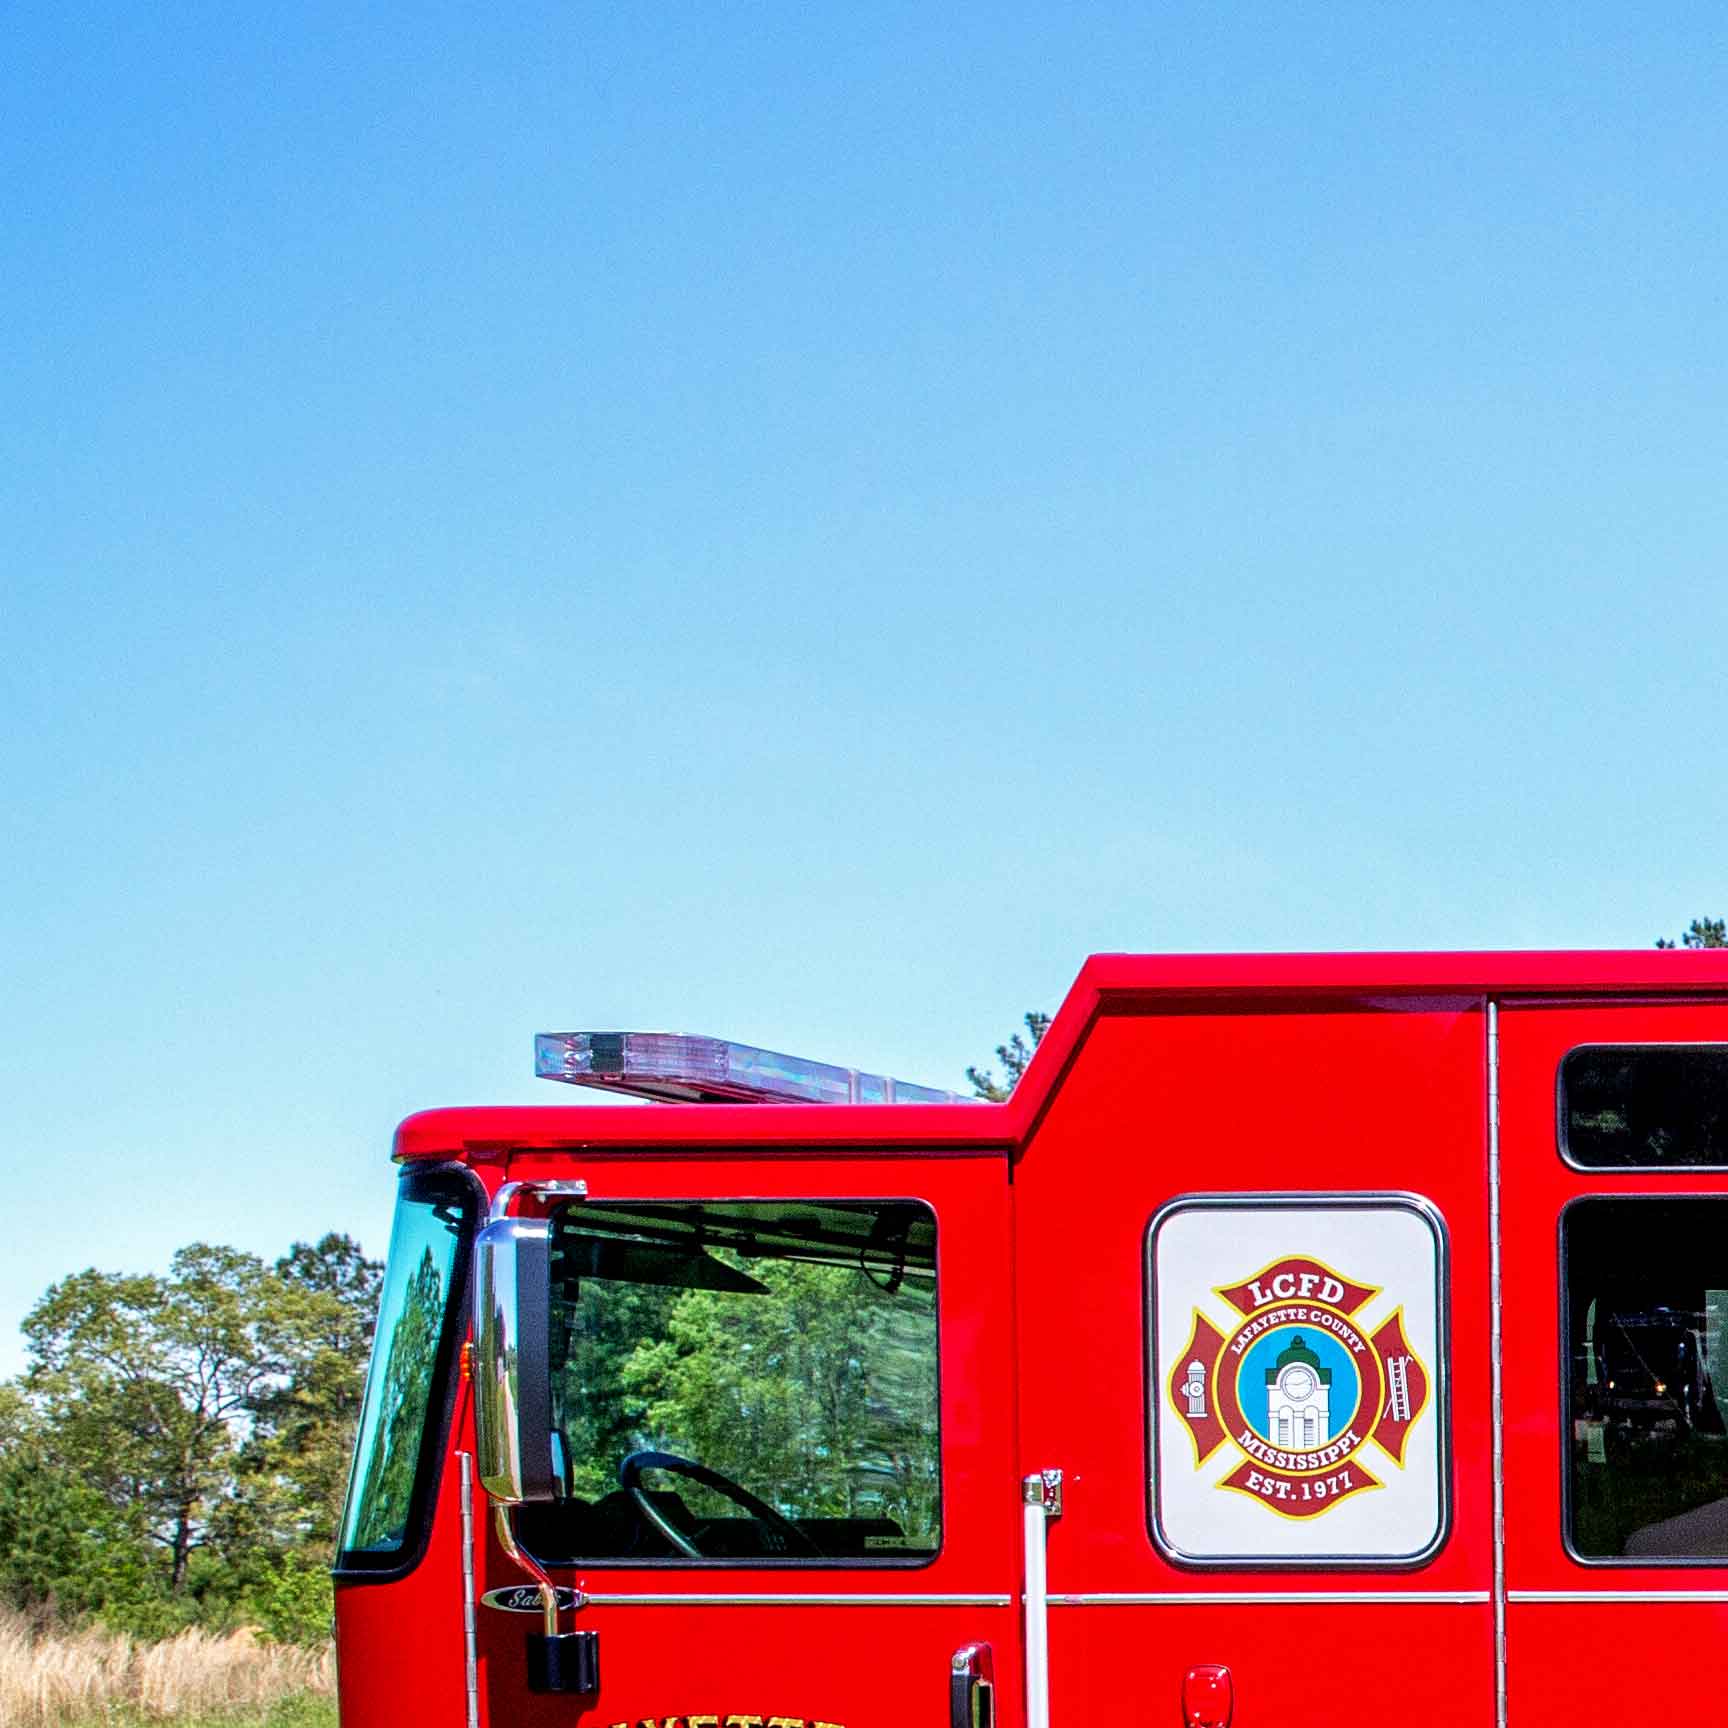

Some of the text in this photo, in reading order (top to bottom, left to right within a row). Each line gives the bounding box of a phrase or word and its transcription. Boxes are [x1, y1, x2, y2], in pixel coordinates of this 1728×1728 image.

[1248, 1273, 1344, 1306] LCFD
[1231, 1308, 1367, 1355] LAFAYETTE COUNTY
[1237, 1430, 1361, 1470] MISSISSIPPI
[1301, 1471, 1353, 1501] 1977
